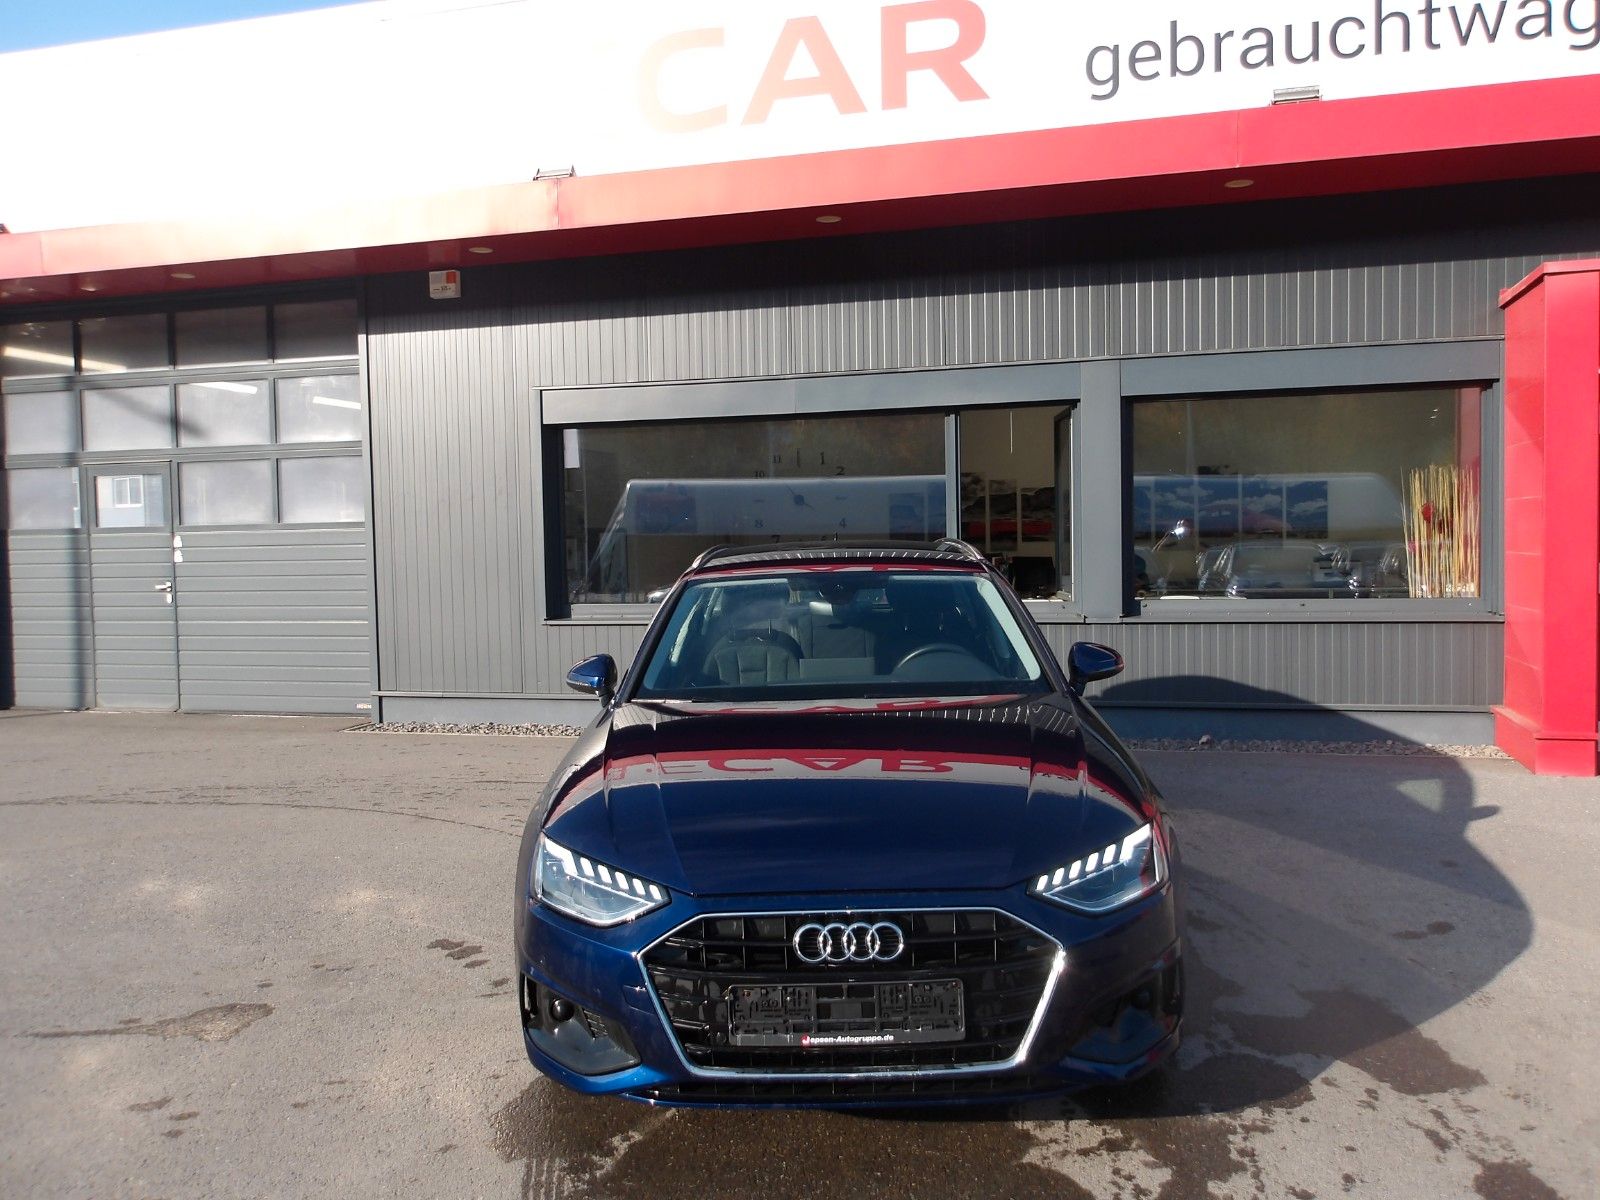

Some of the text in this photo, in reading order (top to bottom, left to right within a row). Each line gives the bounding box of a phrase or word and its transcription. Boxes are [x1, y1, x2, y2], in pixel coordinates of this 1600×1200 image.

[1086, 0, 1600, 100] gebrauchtwag
[836, 466, 845, 476] 2
[839, 518, 847, 528] 4
